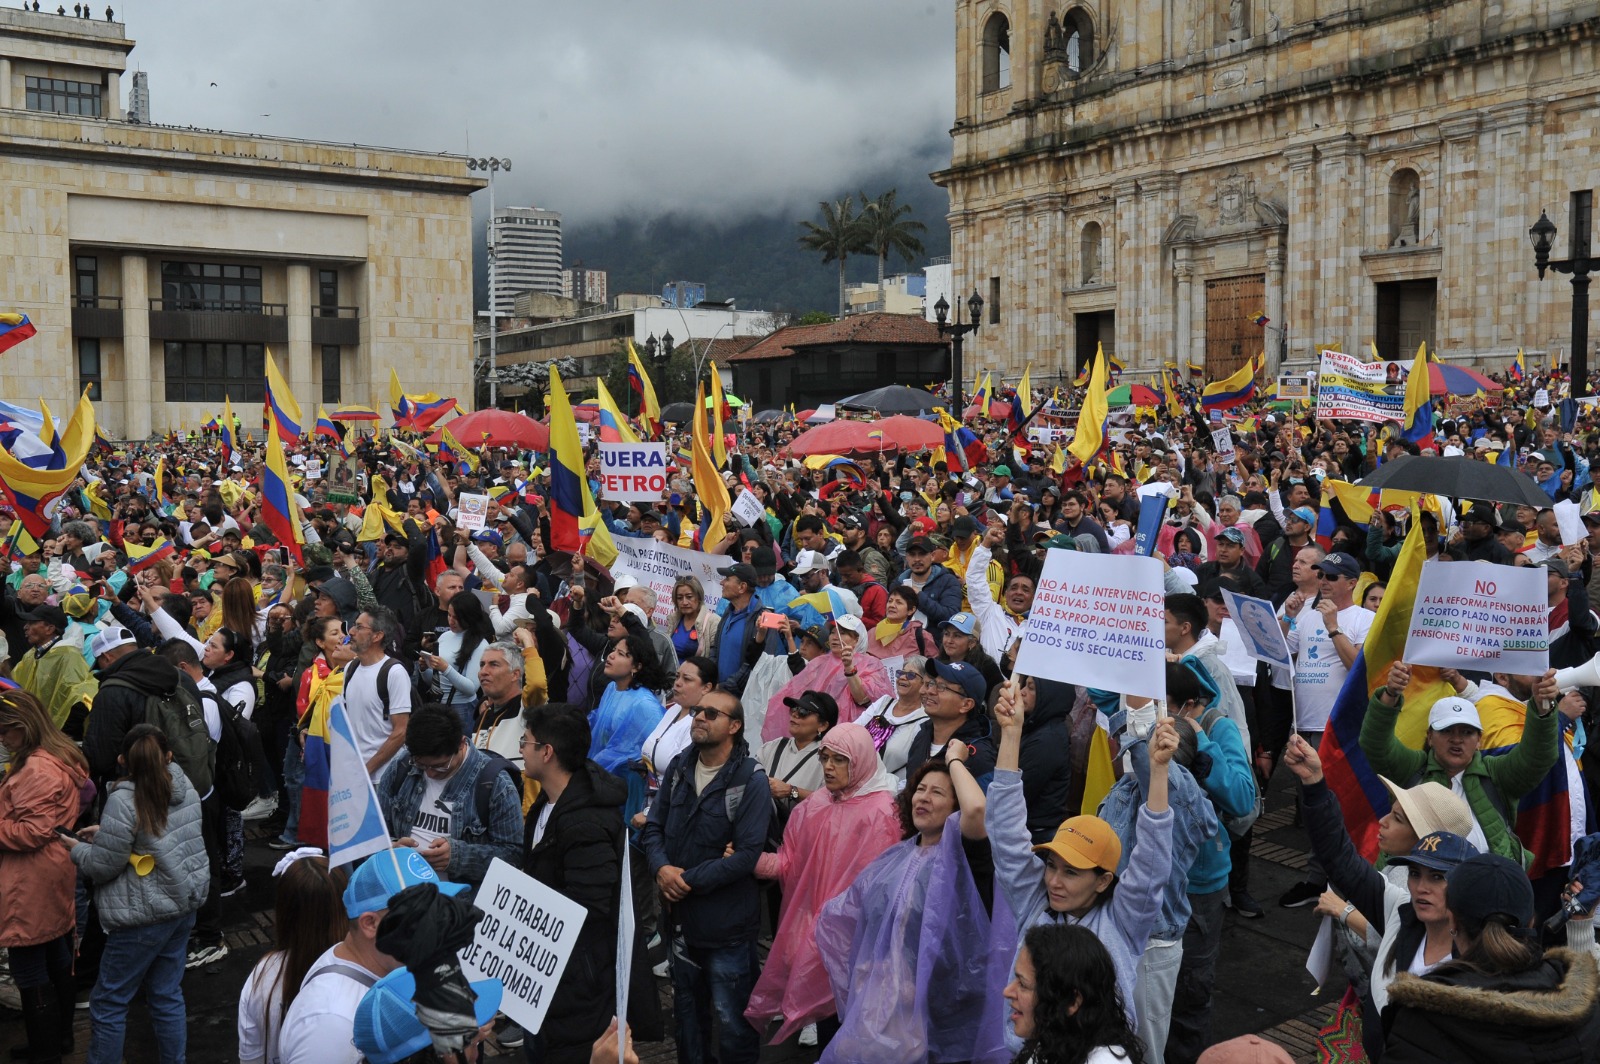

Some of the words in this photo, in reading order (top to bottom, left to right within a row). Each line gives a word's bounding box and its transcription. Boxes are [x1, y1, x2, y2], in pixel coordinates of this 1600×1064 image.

[1325, 352, 1382, 370] DESTRUCTOR
[1336, 395, 1374, 406] REFORMAS
[1136, 532, 1146, 541] es
[643, 563, 651, 572] ES
[652, 564, 662, 575] DE
[662, 567, 679, 578] TODO
[679, 558, 692, 572] VIDA
[1040, 579, 1057, 590] NO
[1060, 582, 1068, 591] A
[1072, 584, 1090, 595] LAS
[1475, 580, 1496, 595] NO
[1036, 592, 1090, 610] ABUSIVAS,
[1093, 601, 1116, 612] SON
[1120, 604, 1134, 615] UN
[1446, 597, 1487, 608] REFORMA
[1490, 602, 1545, 613] PENSIONAL!!
[1033, 605, 1051, 616] LAS
[1054, 609, 1150, 632] EXPROPIACIONES.
[1428, 607, 1459, 617] CORTO
[1462, 611, 1489, 621] PLAZO
[1492, 615, 1507, 624] NO
[1510, 615, 1547, 625] HABRÁN
[1028, 618, 1060, 633] FUERA
[1065, 626, 1099, 641] PETRO,
[1103, 632, 1164, 650] JARAMILLO
[1422, 618, 1460, 629] DEJADO
[1462, 622, 1472, 631] NI
[1475, 624, 1487, 634] UN
[1489, 627, 1513, 637] PESO
[1025, 632, 1062, 647] TODOS
[1065, 640, 1084, 652] SUS
[1087, 643, 1146, 661] SECUACES.
[1412, 630, 1460, 641] PENSIONES
[1463, 635, 1473, 644] NI
[1476, 637, 1500, 647] PARA
[1457, 646, 1468, 655] DE
[1471, 648, 1501, 658] NADIE
[414, 811, 448, 834] UMA
[492, 884, 511, 910] YO
[510, 894, 564, 942] TRABAJO
[480, 914, 500, 941] OR
[499, 925, 516, 952] LA
[516, 936, 558, 977] SALUD
[462, 942, 482, 966] DE
[480, 951, 543, 1008] COLOMBIA
